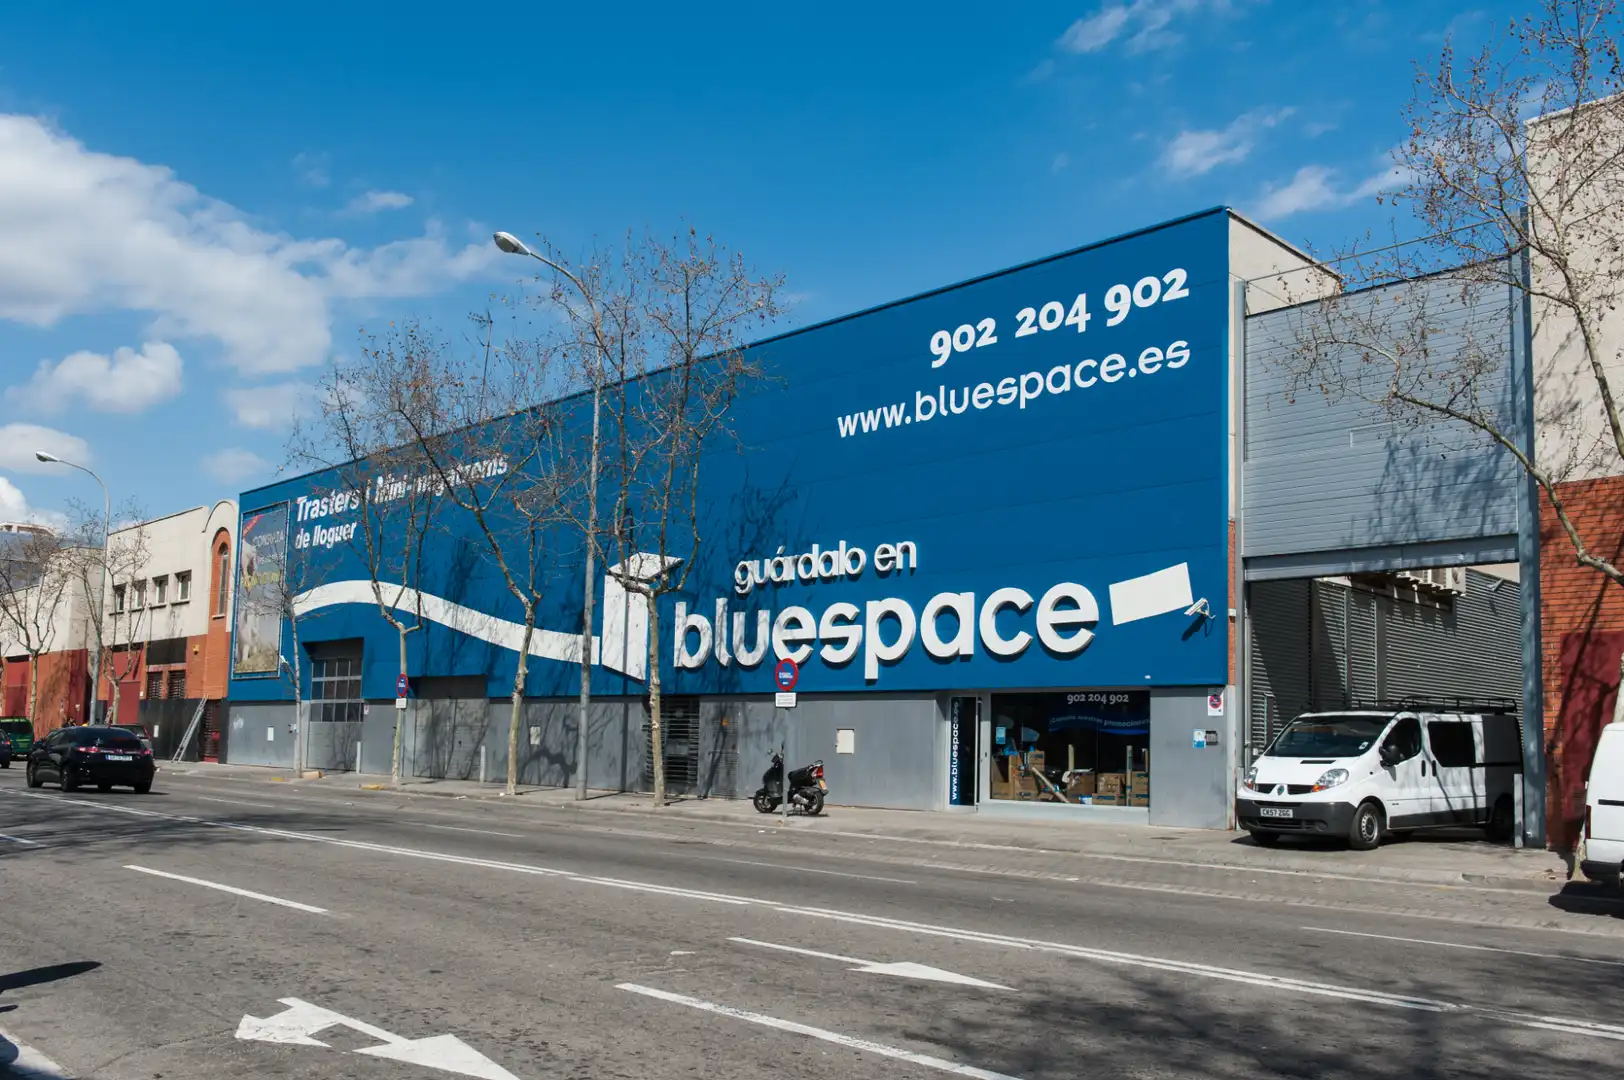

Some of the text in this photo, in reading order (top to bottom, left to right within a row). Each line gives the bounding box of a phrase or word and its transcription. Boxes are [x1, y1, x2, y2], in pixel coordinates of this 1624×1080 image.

[930, 267, 1190, 368] 902 204 902
[837, 340, 1191, 438] www.bluespace.es
[295, 521, 358, 549] de lloguer
[734, 540, 917, 594] guárdalo en
[673, 582, 1100, 680] bluespace
[1067, 693, 1129, 705] 902 204 902
